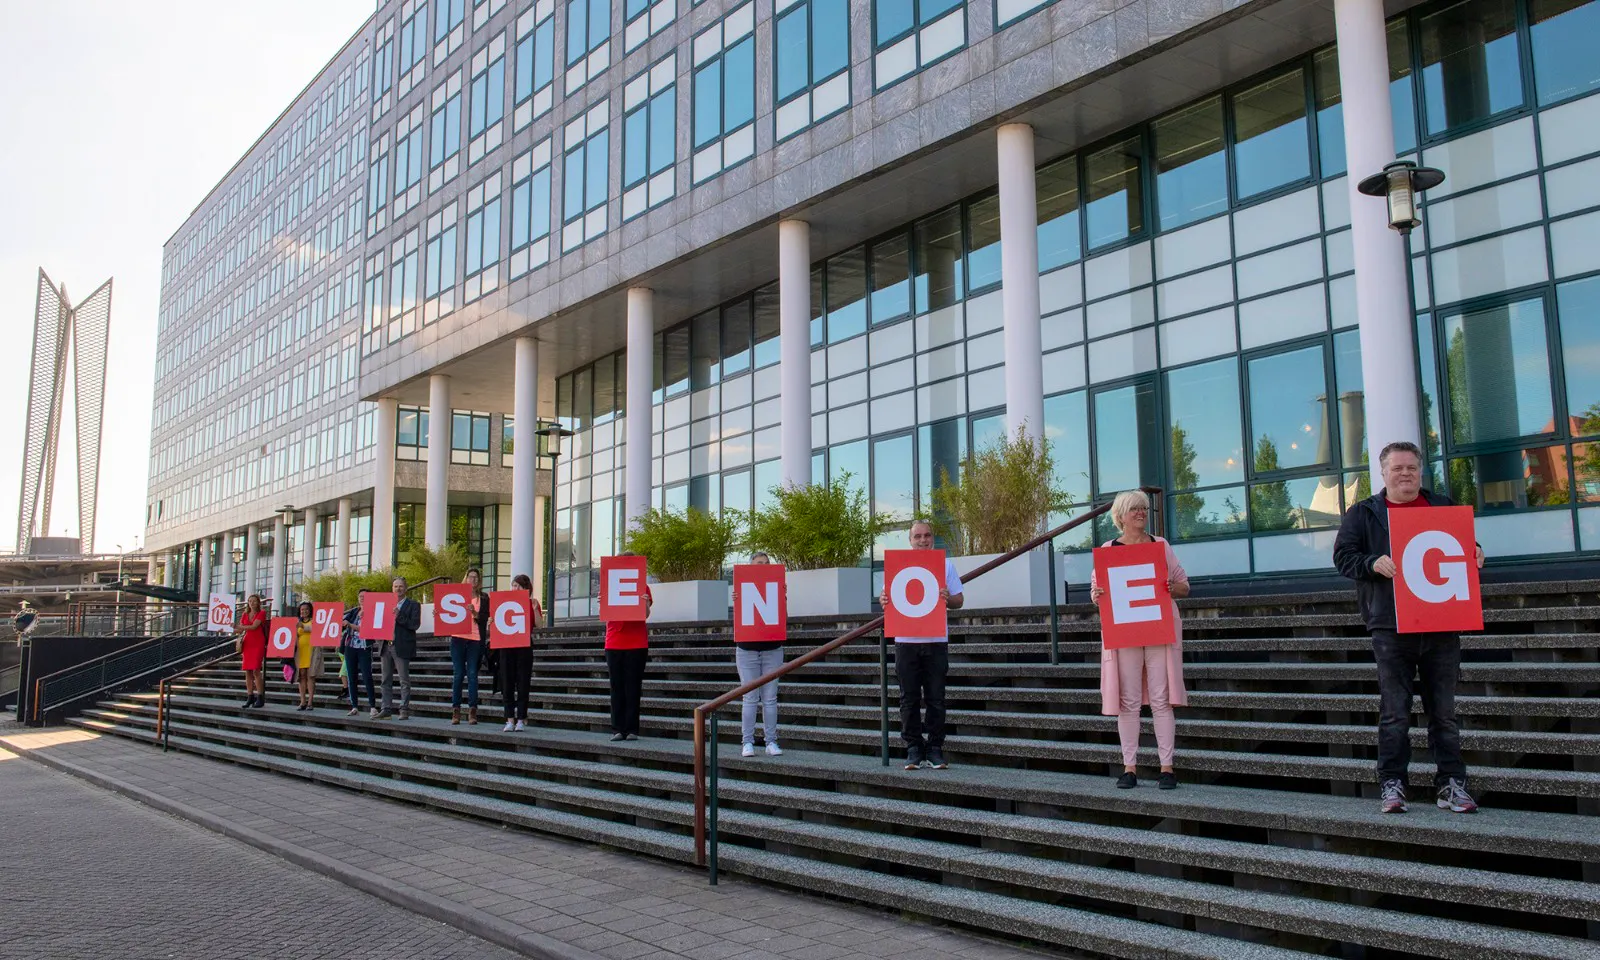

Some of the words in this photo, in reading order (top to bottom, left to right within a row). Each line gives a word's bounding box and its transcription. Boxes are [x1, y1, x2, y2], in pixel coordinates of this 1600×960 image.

[1402, 531, 1469, 602] G
[608, 570, 639, 605] E
[741, 582, 778, 625] N
[891, 567, 939, 617] O
[1108, 564, 1161, 624] E
[213, 606, 231, 624] 0%
[315, 608, 340, 638] %
[373, 602, 384, 628] I
[440, 594, 466, 623] S
[495, 602, 525, 634] G
